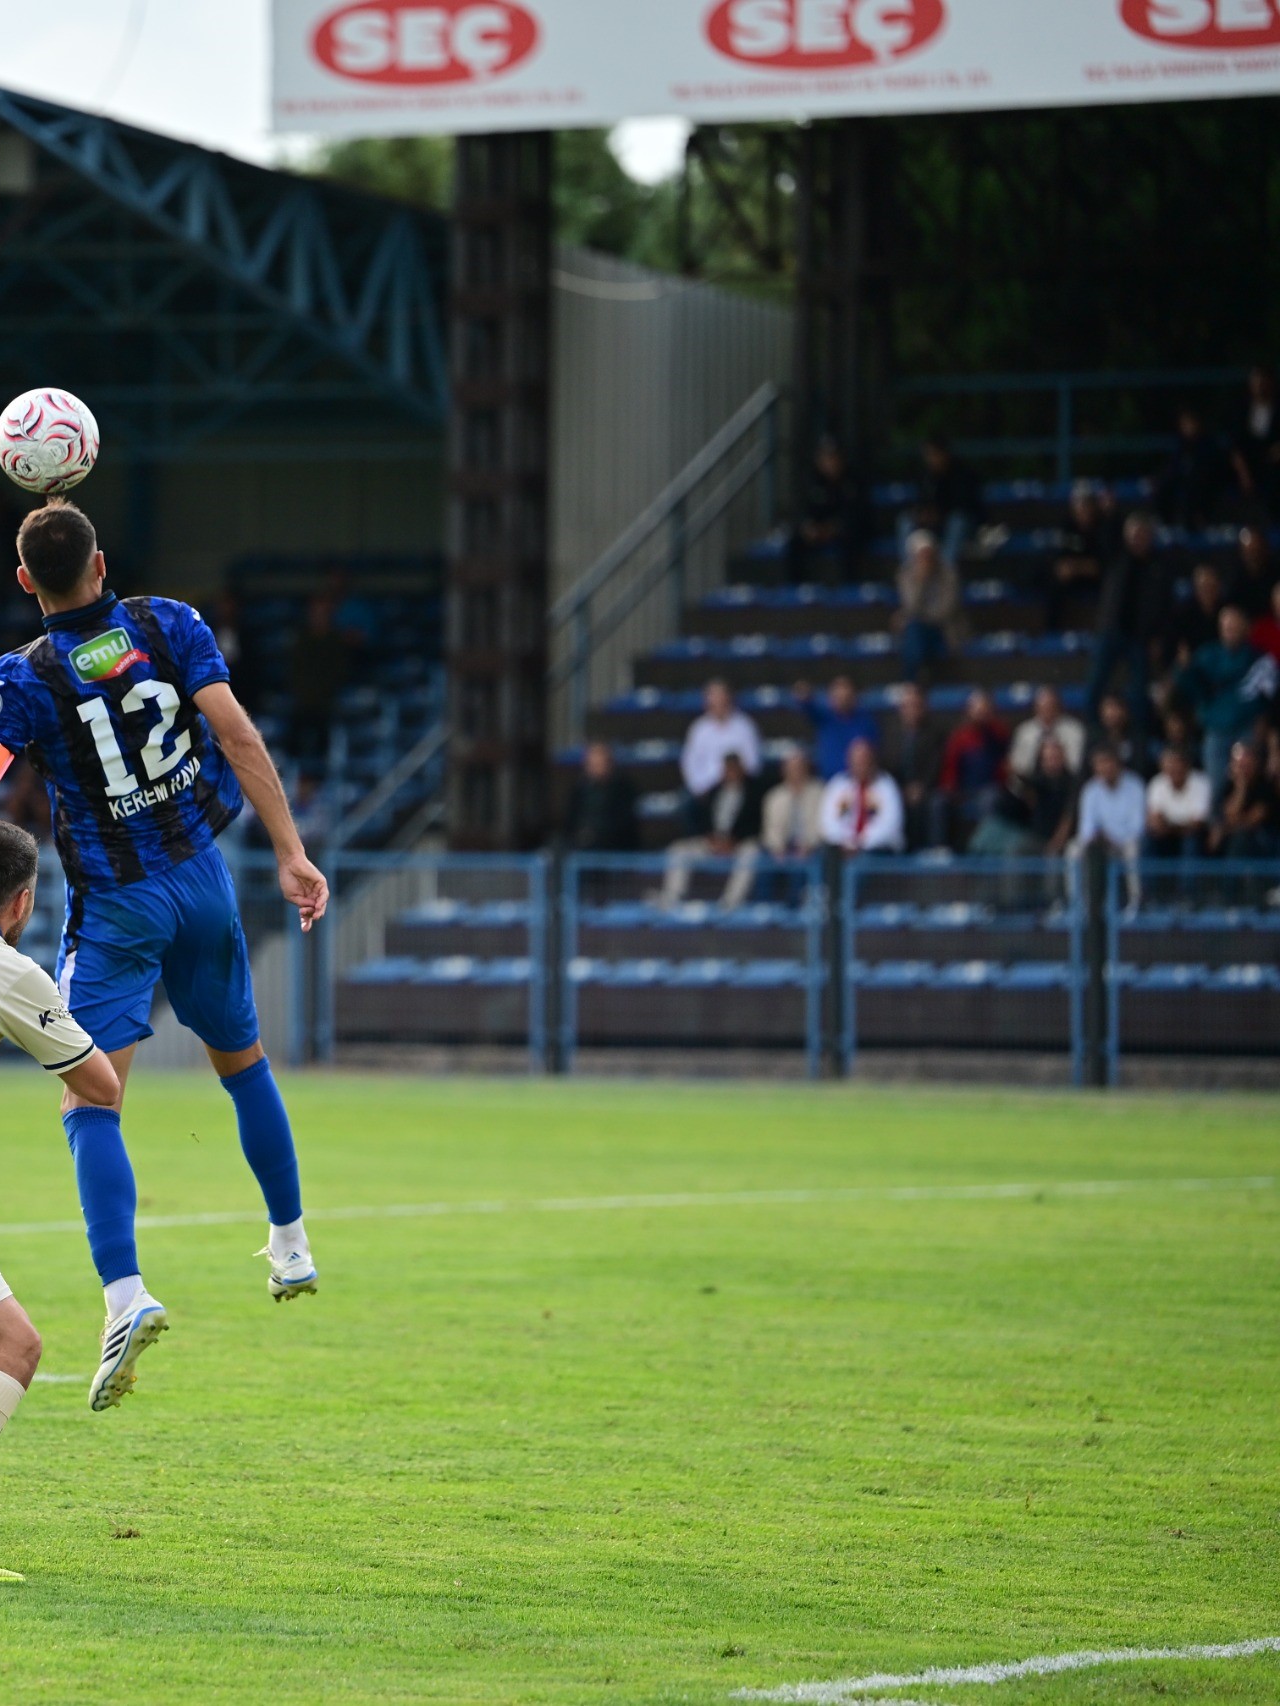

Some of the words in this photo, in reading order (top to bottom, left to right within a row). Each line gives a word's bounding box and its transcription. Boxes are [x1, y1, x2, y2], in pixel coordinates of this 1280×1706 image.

[329, 6, 511, 80] SEÇ
[726, 0, 917, 61] SEÇ
[1145, 0, 1280, 36] SE
[76, 634, 129, 671] emu
[76, 679, 191, 797] 12
[108, 782, 169, 820] KEREM
[170, 756, 201, 795] KAYA
